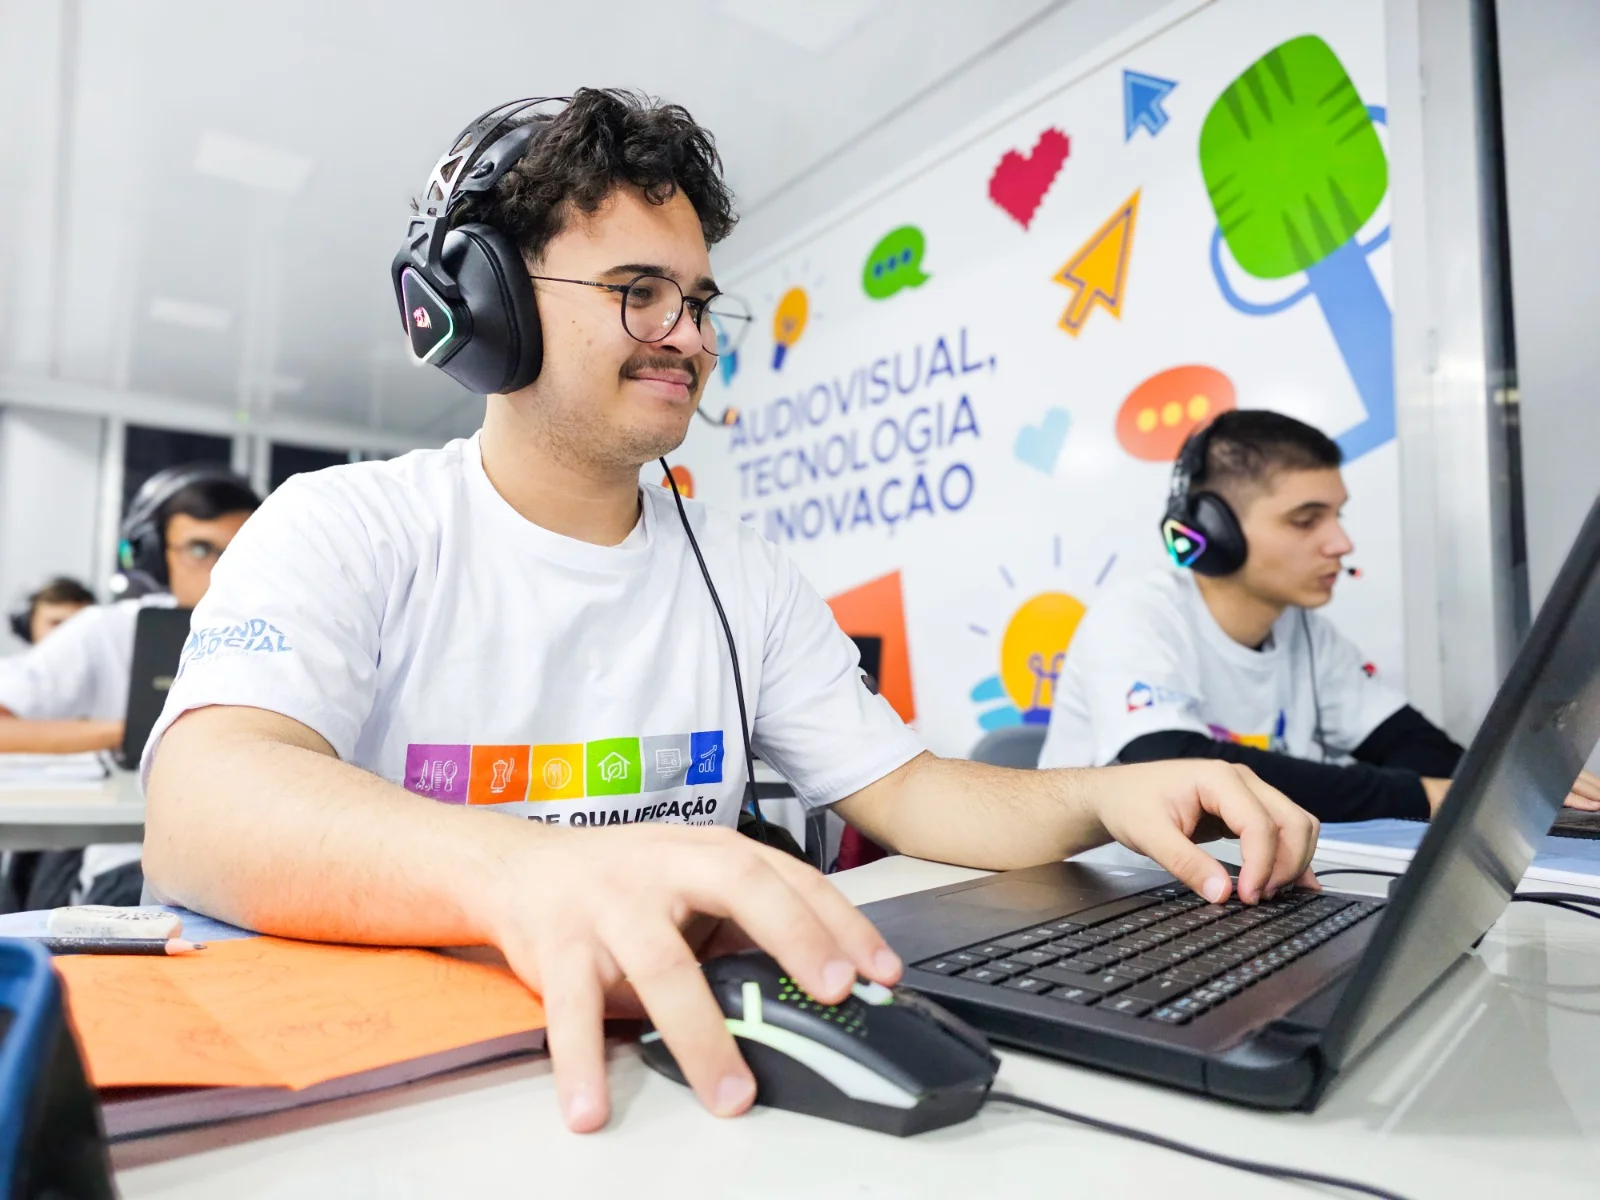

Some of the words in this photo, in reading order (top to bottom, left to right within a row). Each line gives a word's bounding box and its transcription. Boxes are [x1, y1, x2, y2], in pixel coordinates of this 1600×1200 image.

[730, 327, 997, 453] AUDIOVISUAL,
[737, 394, 980, 500] TECNOLOGIA
[764, 457, 974, 544] INOVAÇÃO
[190, 635, 292, 660] SOCIAL
[569, 796, 717, 828] QUALIFICAÇÃO
